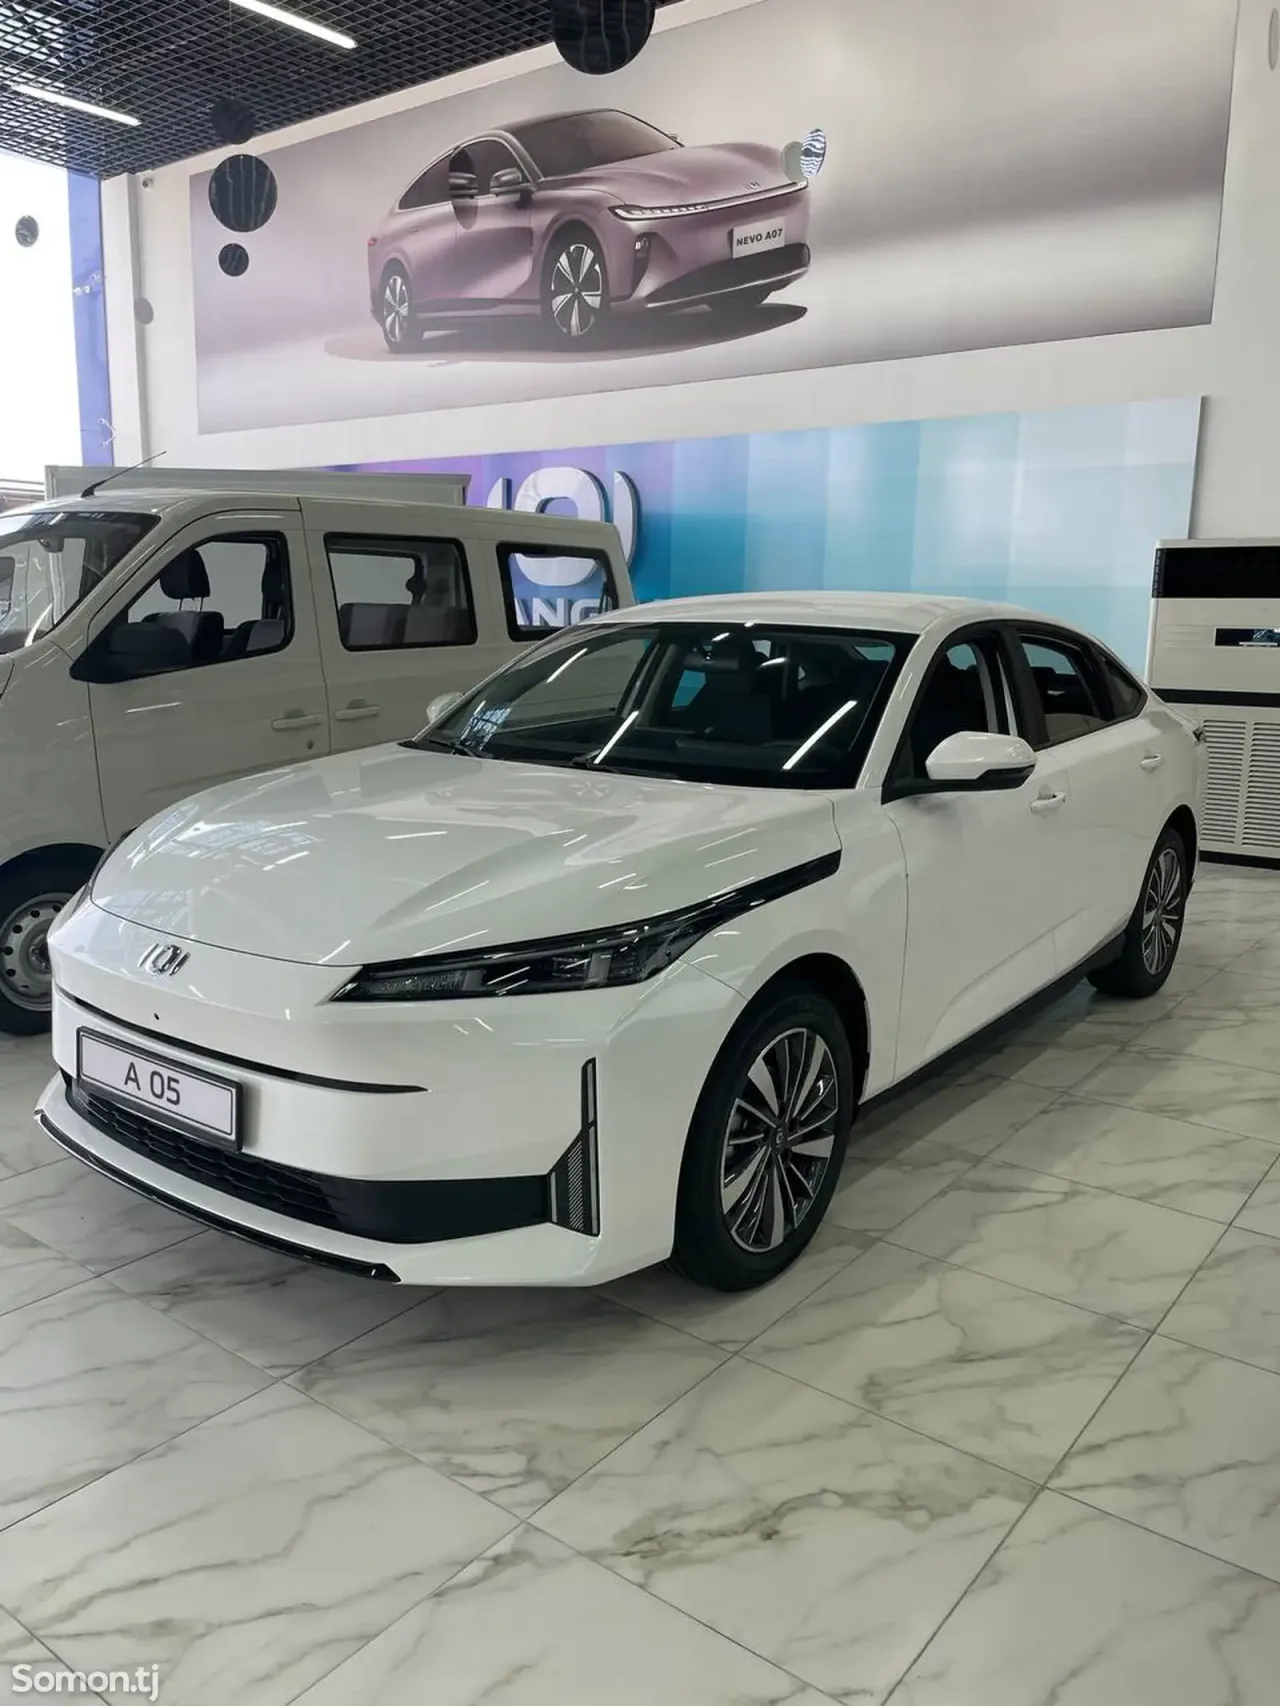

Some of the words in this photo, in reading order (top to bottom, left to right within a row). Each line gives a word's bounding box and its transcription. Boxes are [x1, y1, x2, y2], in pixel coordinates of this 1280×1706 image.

[736, 233, 763, 246] NEVO
[765, 228, 783, 240] A07
[124, 1061, 141, 1091] A
[150, 1070, 181, 1105] 05
